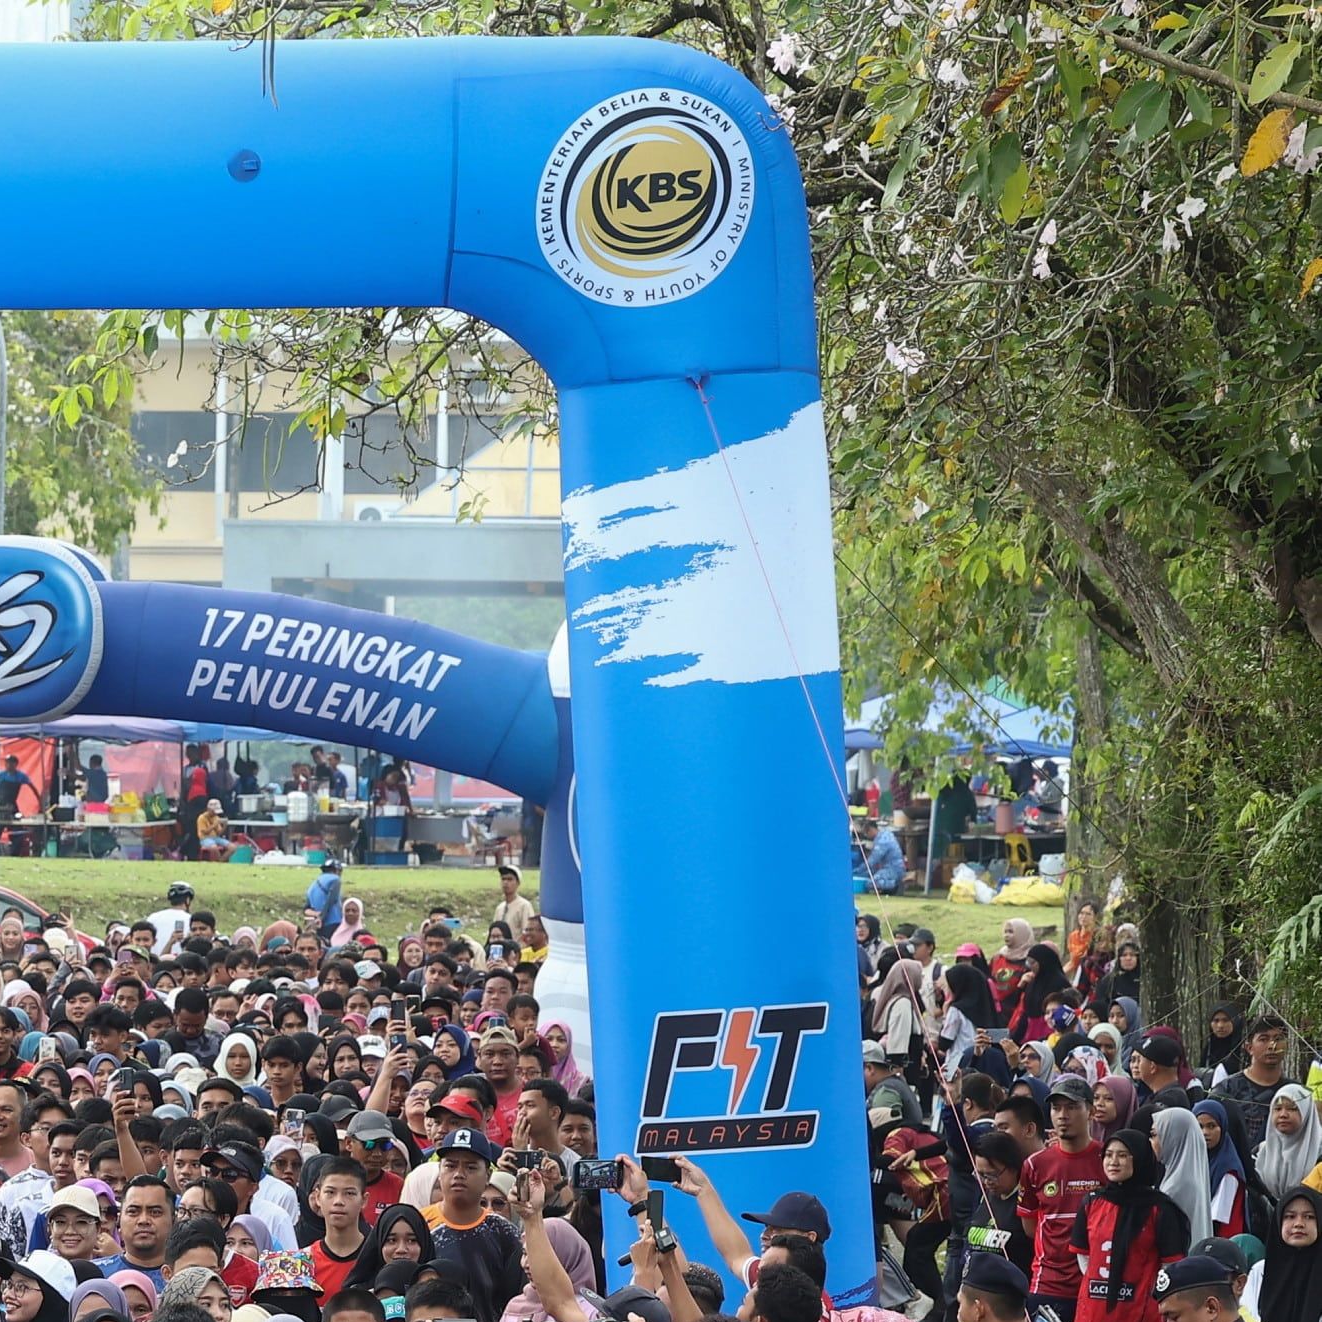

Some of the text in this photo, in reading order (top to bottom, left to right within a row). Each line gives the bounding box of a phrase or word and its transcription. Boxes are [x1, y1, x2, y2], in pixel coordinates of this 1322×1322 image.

[541, 117, 594, 246] KEMENTERIAN
[597, 91, 650, 118] BELIA
[679, 94, 733, 134] SUKAN
[617, 169, 704, 213] KBS
[726, 156, 753, 246] MINISTRY
[556, 257, 615, 300] SPORTS
[708, 248, 728, 273] OF
[644, 272, 707, 302] YOUTH
[198, 607, 462, 694] 17 PERINGKAT
[185, 658, 438, 742] PENULENAN
[643, 1120, 810, 1148] MALAYSIA
